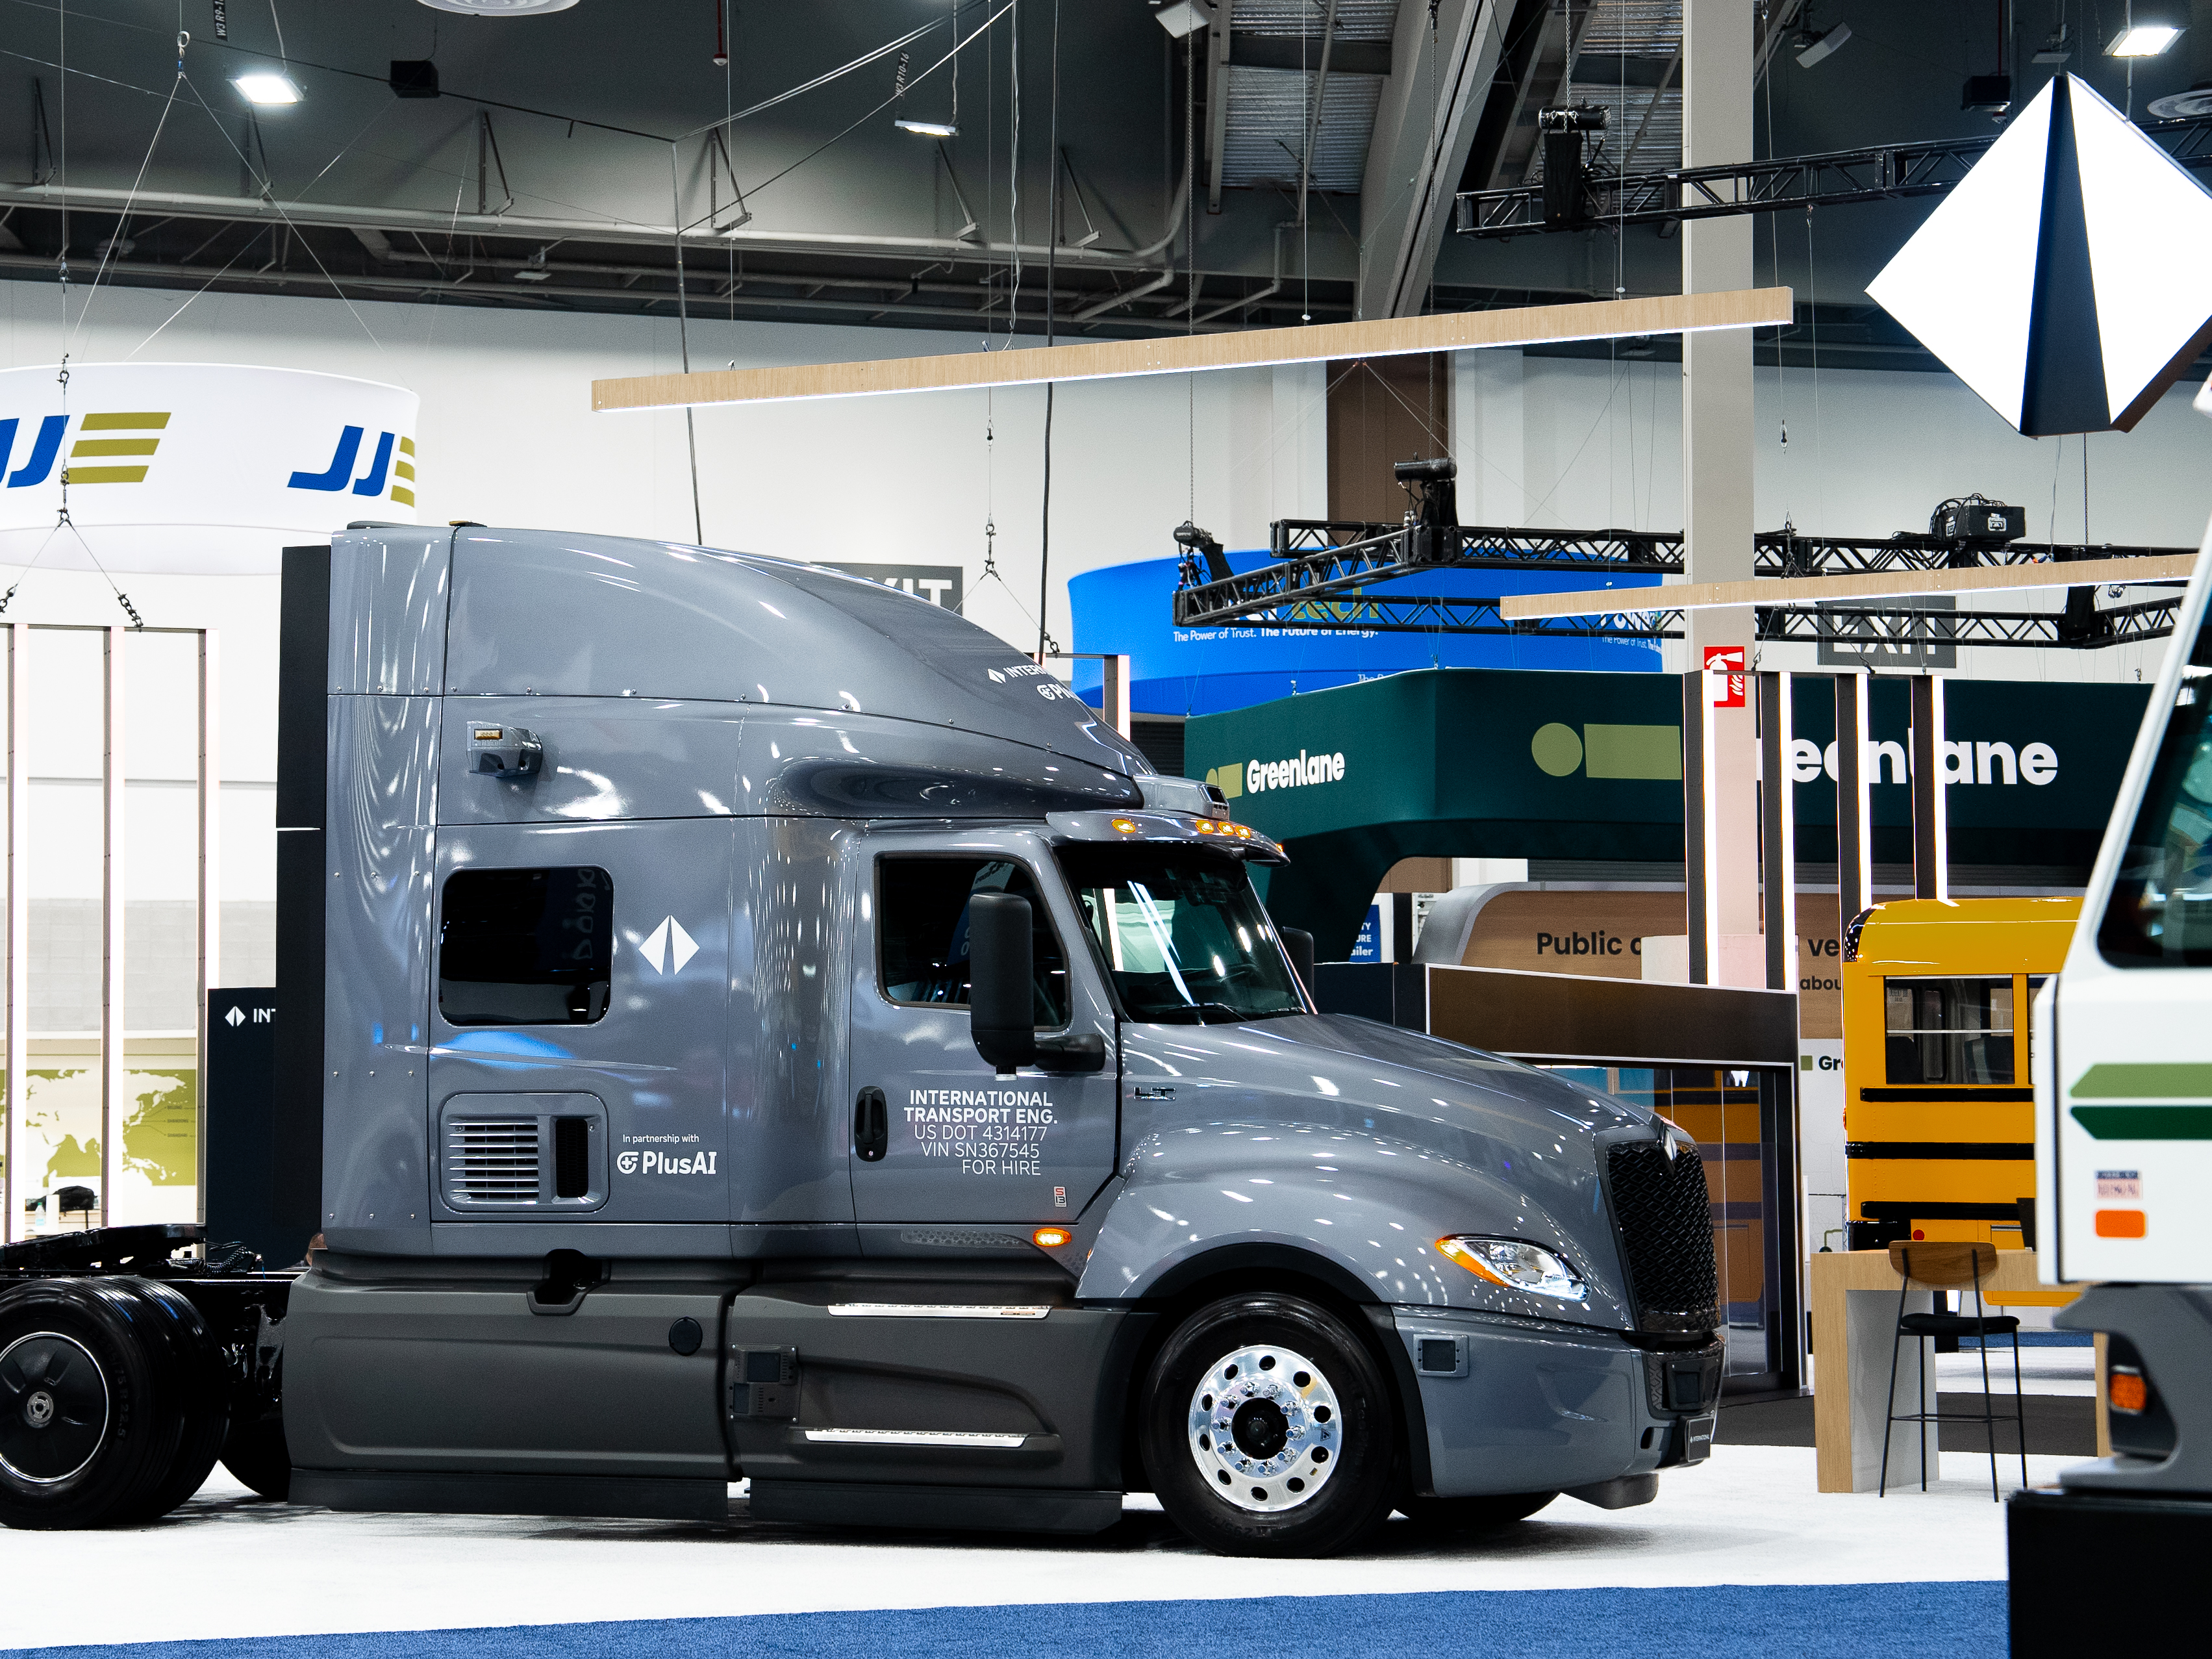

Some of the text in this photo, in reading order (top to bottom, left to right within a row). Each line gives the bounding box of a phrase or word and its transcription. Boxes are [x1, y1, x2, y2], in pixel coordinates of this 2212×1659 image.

[214, 0, 227, 36] W3 R9-1
[896, 53, 909, 83] R10-16
[1174, 631, 1188, 642] The
[1190, 630, 1216, 641] Power
[1218, 627, 1229, 639] of
[1231, 627, 1257, 638] Trust.
[1261, 628, 1279, 637] The
[1282, 628, 1318, 637] Future
[1246, 749, 1345, 794] Greenlane
[1537, 930, 1622, 956] Public
[1818, 1056, 1843, 1070] Gr
[909, 1089, 1053, 1106] INTERNATIONAL
[903, 1107, 1058, 1124] TRANSPORT ENG.
[623, 1133, 699, 1145] In partnership with
[914, 1124, 1048, 1141] US DOT 4314177
[921, 1142, 1040, 1158] VIN SN367545
[642, 1151, 717, 1174] PlusAI
[962, 1159, 1041, 1176] FOR HIRE
